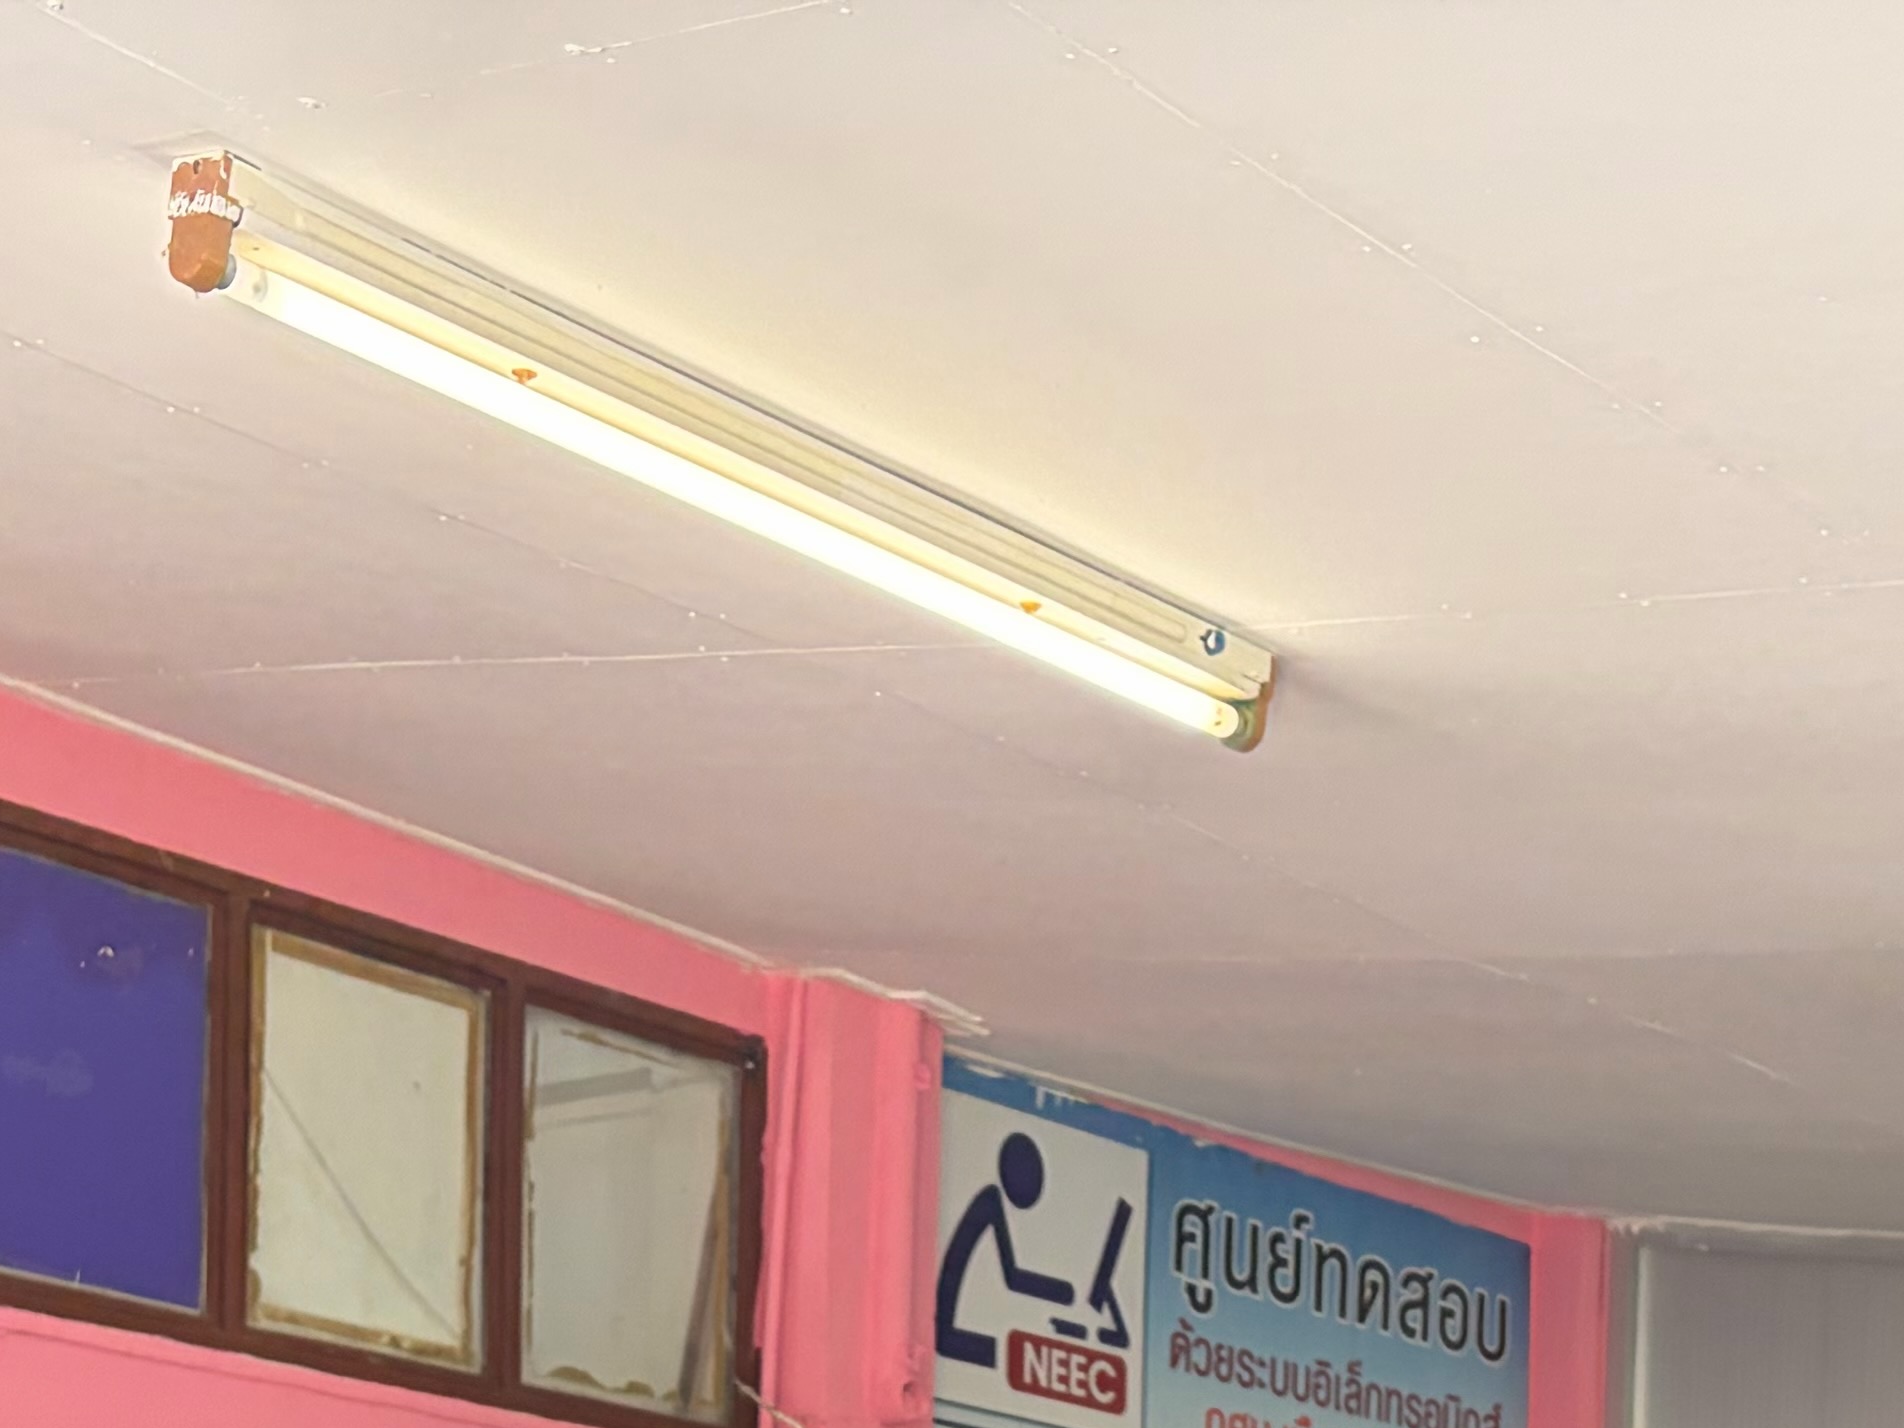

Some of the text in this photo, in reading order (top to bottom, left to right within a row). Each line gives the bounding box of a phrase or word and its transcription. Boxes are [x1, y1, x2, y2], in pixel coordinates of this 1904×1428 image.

[1173, 1201, 1509, 1364] ศูนย์ทดสอบ
[1022, 1340, 1118, 1405] NEEC
